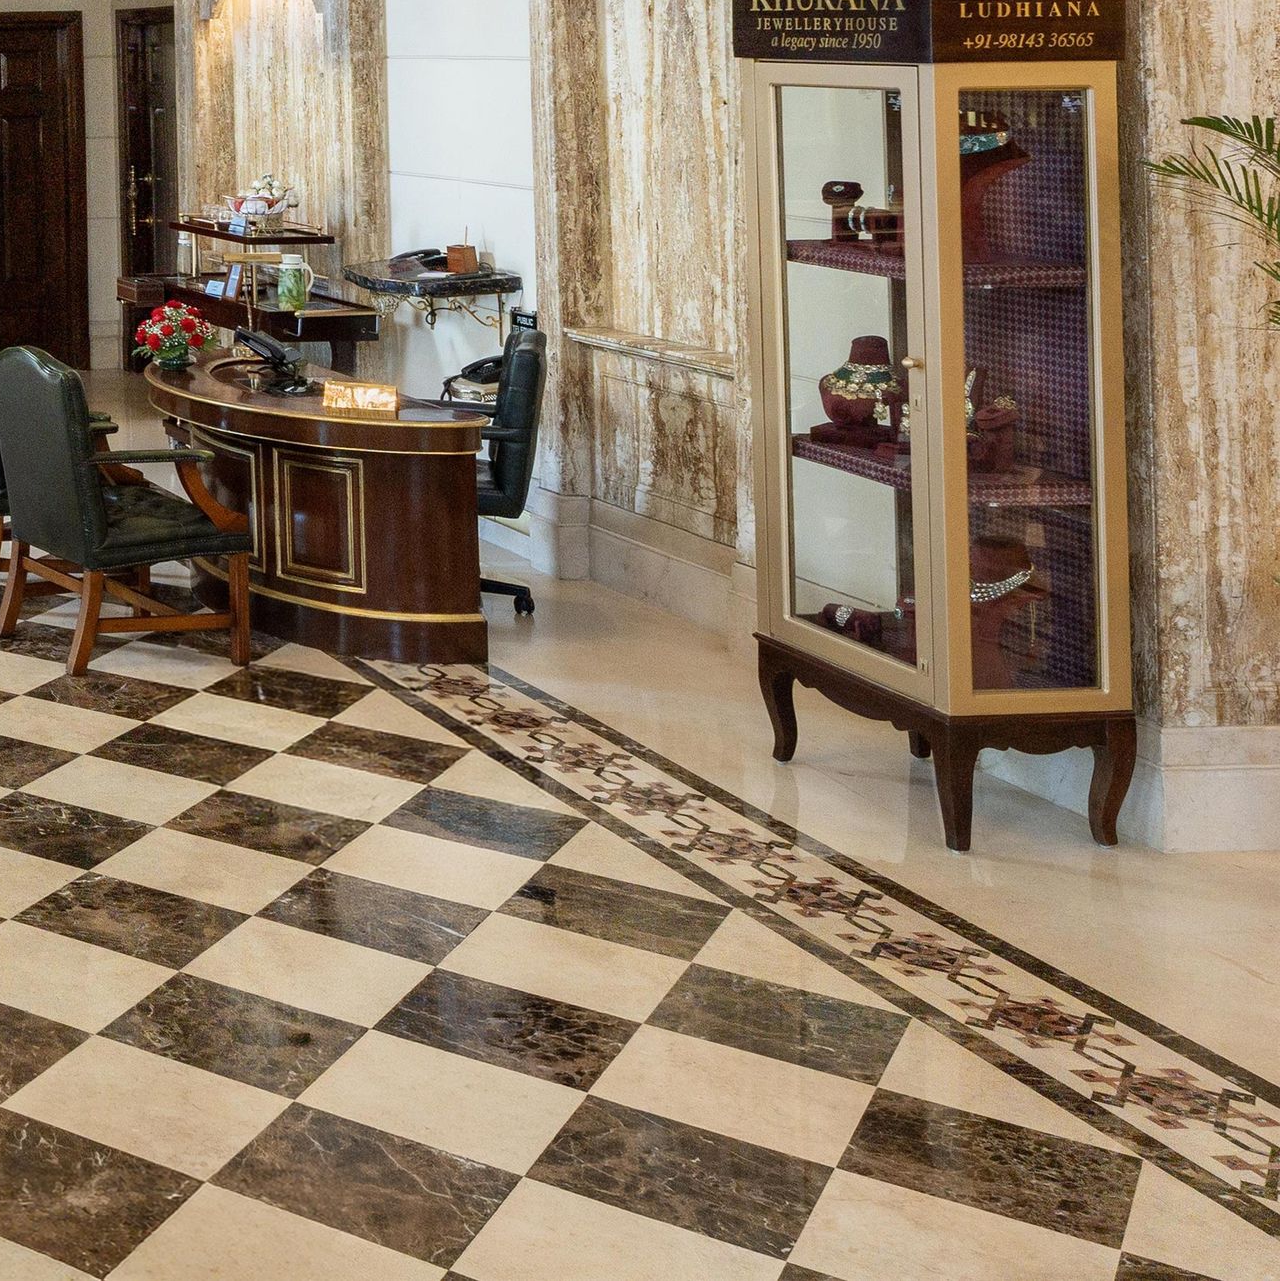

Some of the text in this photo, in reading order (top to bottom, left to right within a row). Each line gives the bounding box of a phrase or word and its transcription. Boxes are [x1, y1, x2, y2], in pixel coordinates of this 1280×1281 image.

[959, 1, 1100, 19] LUDHIANA
[771, 33, 882, 51] a legacy since 1950
[963, 32, 1095, 49] +91-98143 36565
